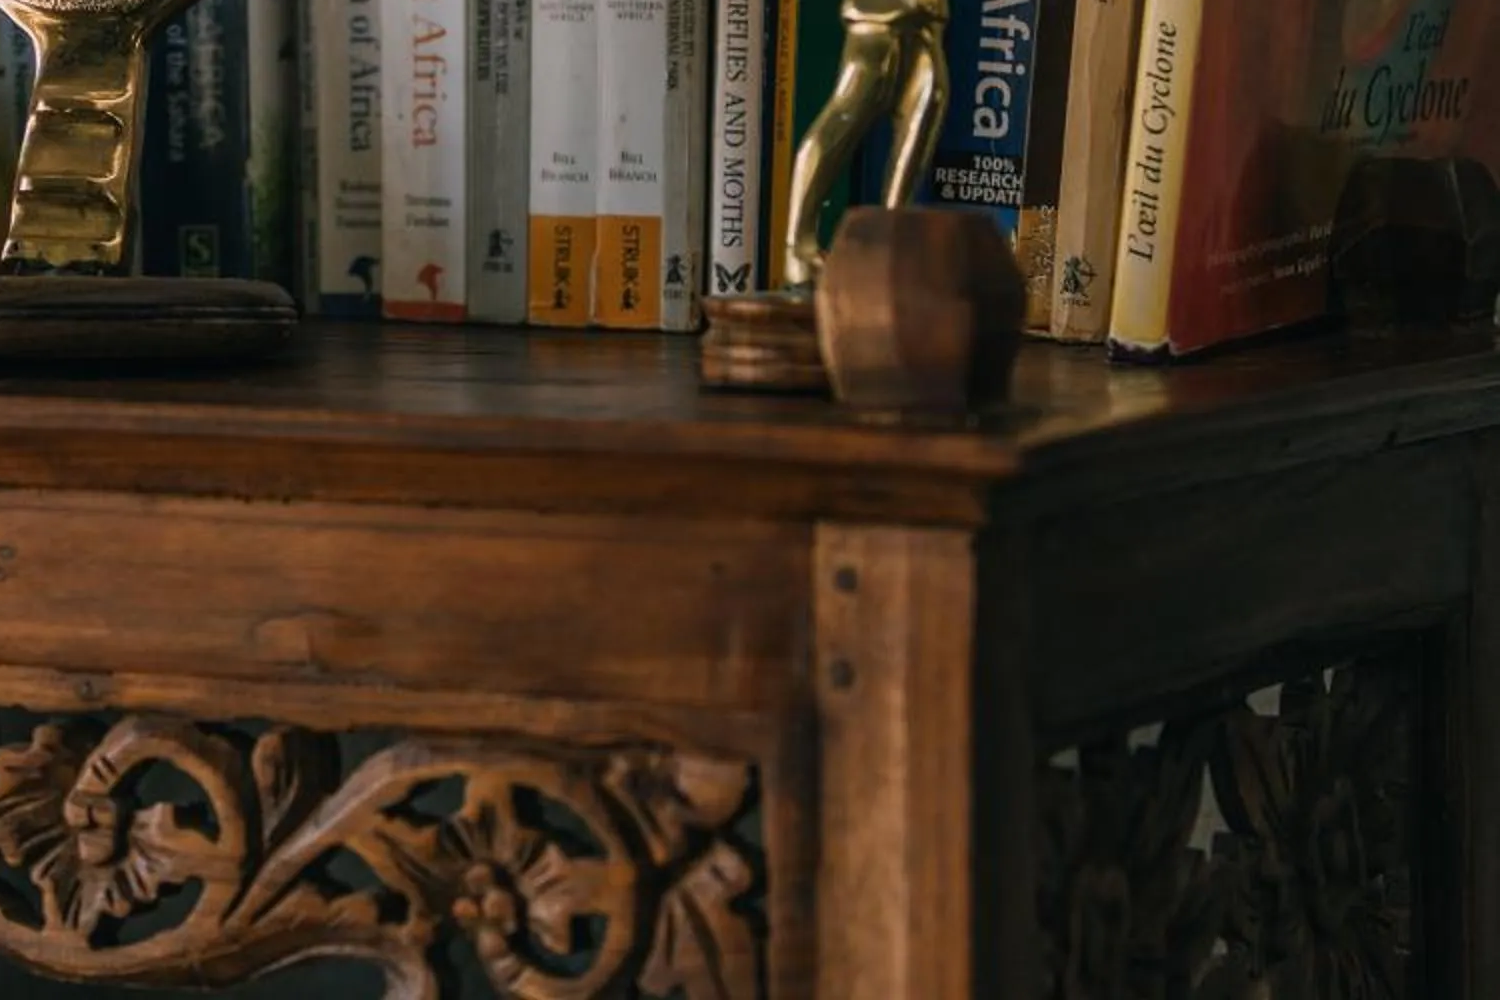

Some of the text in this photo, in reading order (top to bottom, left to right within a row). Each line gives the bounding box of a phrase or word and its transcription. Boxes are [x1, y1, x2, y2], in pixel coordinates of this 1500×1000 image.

[349, 15, 380, 50] of
[349, 57, 382, 152] Africa
[412, 15, 447, 150] Africa
[1141, 20, 1179, 136] Cyclone
[1320, 57, 1470, 147] du Cyclone
[723, 90, 748, 147] AND
[940, 184, 955, 200] &
[973, 154, 1015, 172] 100%
[1135, 148, 1165, 187] du
[722, 158, 747, 248] MOTHS
